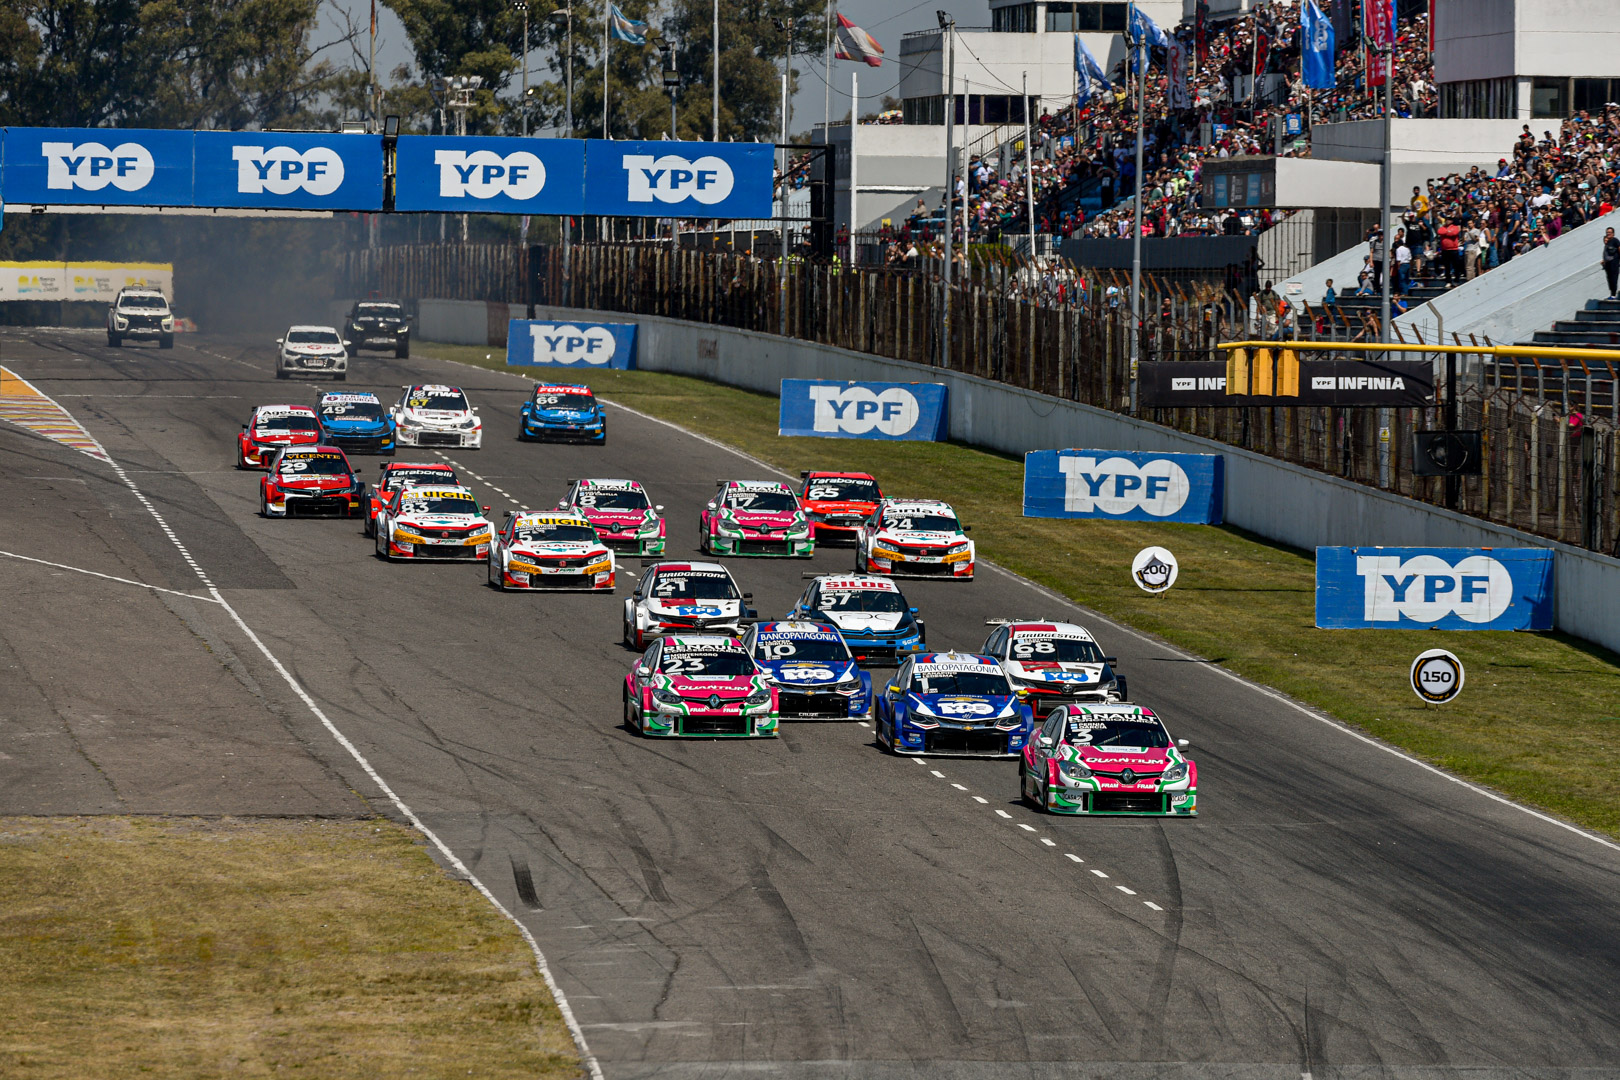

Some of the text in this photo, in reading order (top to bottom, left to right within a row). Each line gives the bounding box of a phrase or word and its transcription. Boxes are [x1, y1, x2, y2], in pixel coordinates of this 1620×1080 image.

[60, 156, 138, 177] YPF
[251, 159, 327, 181] YPF
[453, 164, 529, 185] YPF
[640, 168, 717, 190] YPF
[543, 336, 603, 354] YPF
[409, 398, 429, 407] 67
[536, 396, 558, 405] 66
[322, 406, 346, 414] 49
[827, 400, 903, 421] YPF
[279, 462, 308, 472] 29
[391, 469, 453, 477] Taraborelli
[811, 478, 873, 486] Taraborelli
[1079, 473, 1170, 499] YPF
[808, 487, 839, 498] 65
[579, 495, 597, 506] 8
[727, 497, 755, 509] 17
[401, 502, 429, 513] 83
[885, 518, 913, 530] 24
[519, 530, 533, 541] 5
[1143, 565, 1167, 575] 200
[655, 580, 686, 592] 41
[1380, 574, 1490, 603] YPF
[820, 592, 852, 606] 57
[760, 632, 839, 642] BANCOPATAGONIA
[663, 644, 746, 653] RENAULT
[759, 644, 797, 660] 10
[1014, 642, 1056, 654] 68
[663, 657, 705, 674] 23
[917, 663, 999, 674] BANCOPATAGONIA
[1422, 670, 1452, 683] 150
[916, 677, 930, 694] 1
[1068, 713, 1158, 722] RENAULT
[1071, 728, 1094, 743] 3
